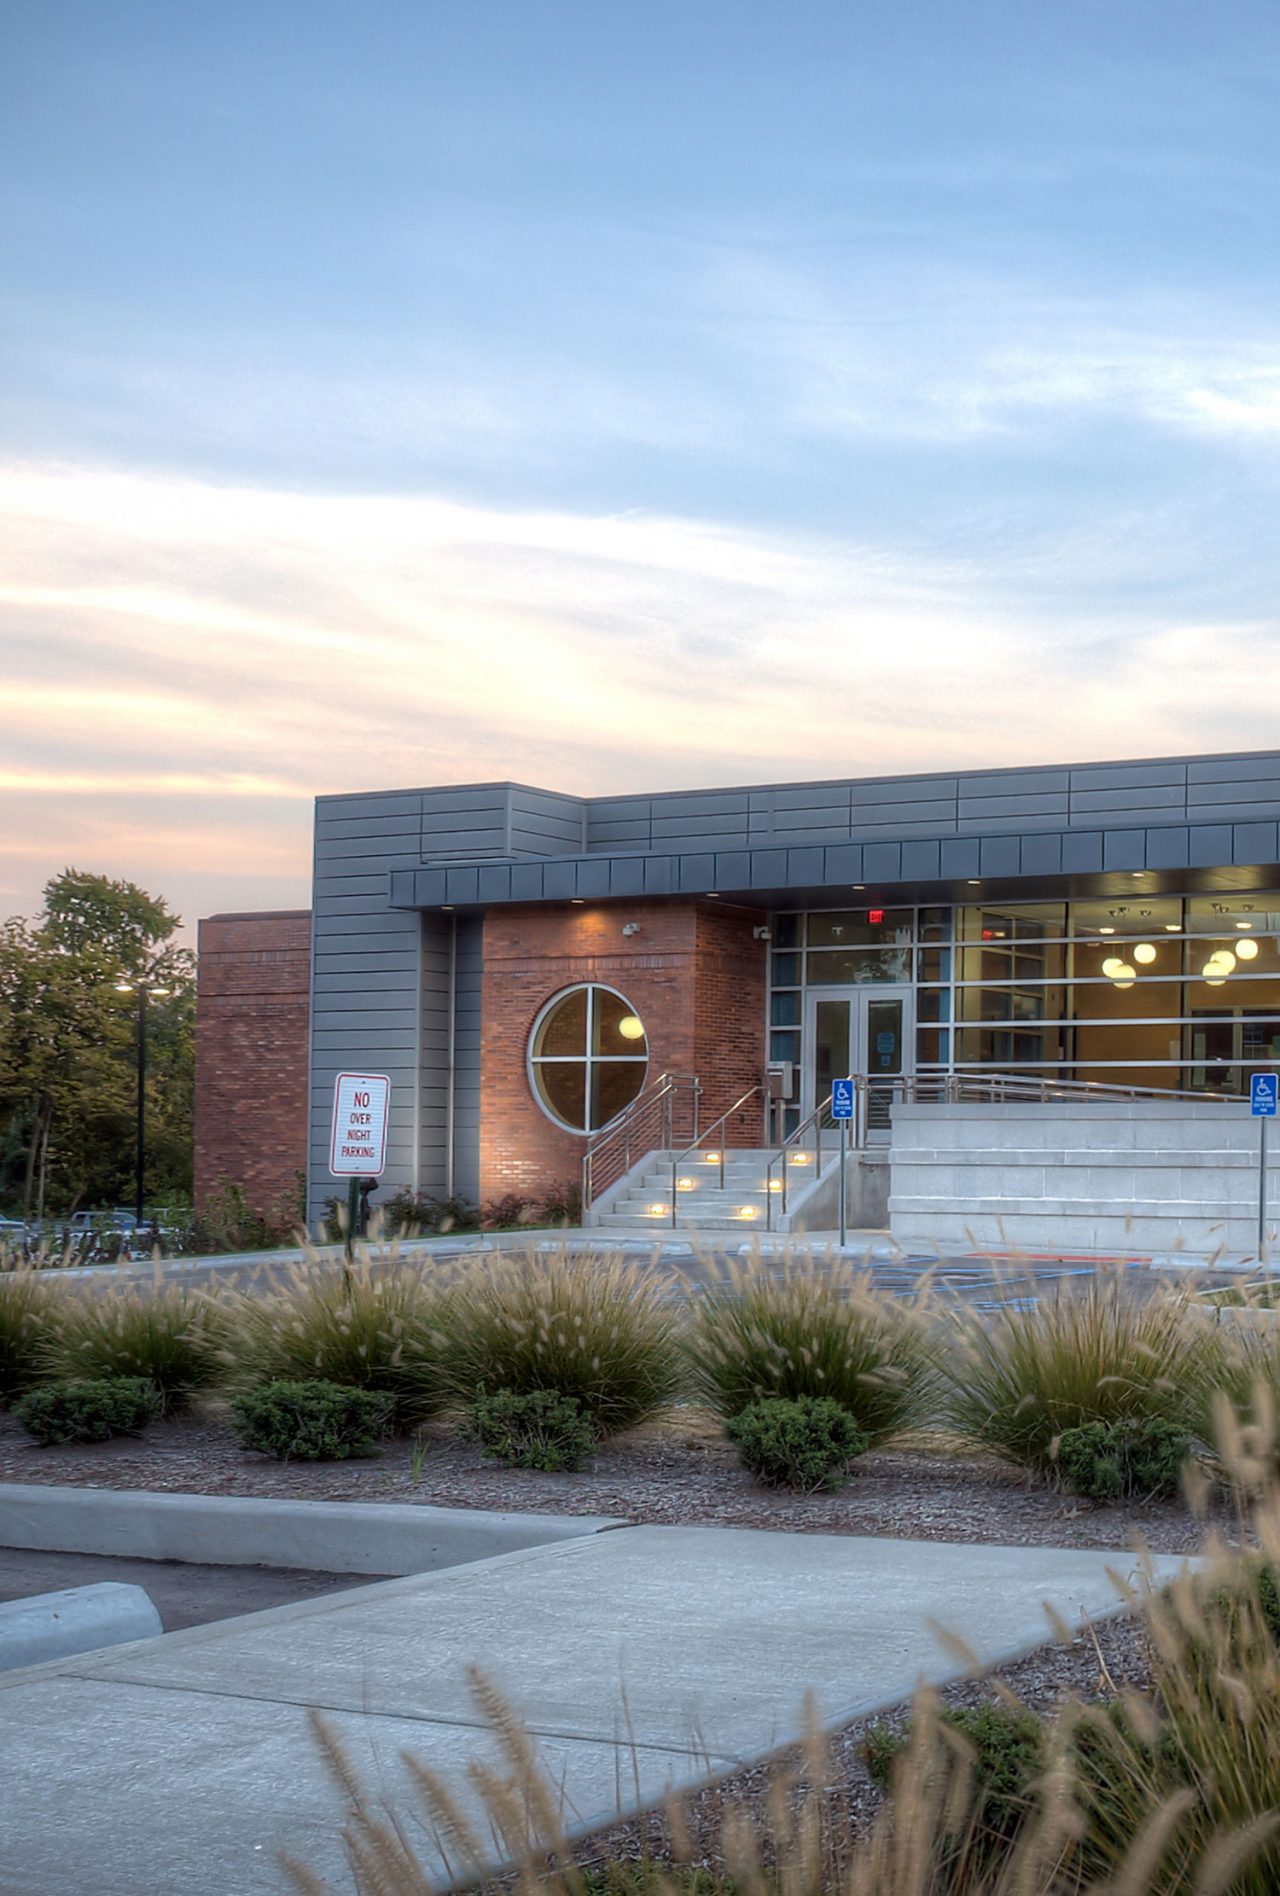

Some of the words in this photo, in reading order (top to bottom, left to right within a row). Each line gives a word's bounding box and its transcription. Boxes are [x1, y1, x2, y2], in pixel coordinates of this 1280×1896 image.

[353, 1092, 370, 1108] NO
[350, 1112, 371, 1124] OVER
[347, 1130, 371, 1141] NIGHT
[341, 1146, 375, 1158] PARKING
